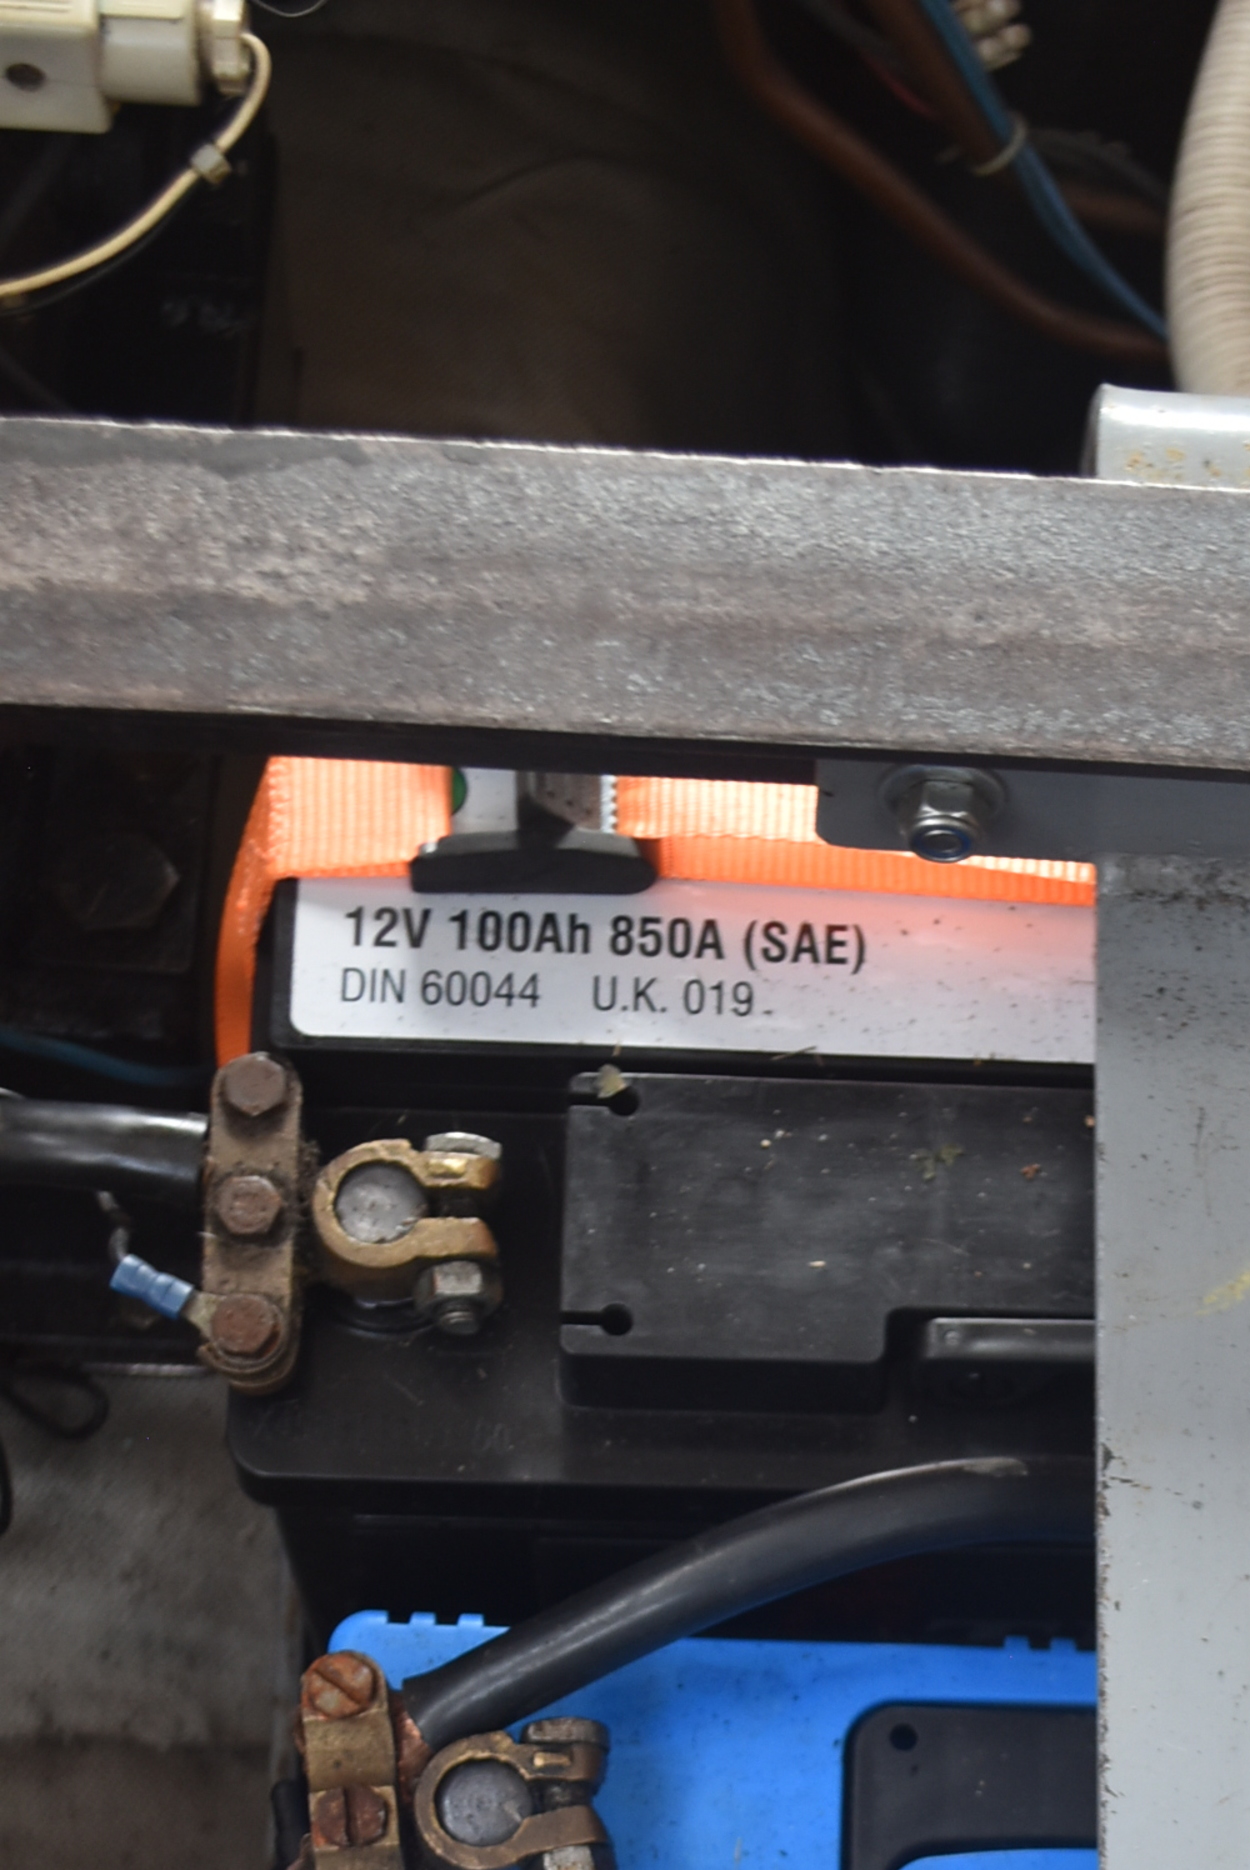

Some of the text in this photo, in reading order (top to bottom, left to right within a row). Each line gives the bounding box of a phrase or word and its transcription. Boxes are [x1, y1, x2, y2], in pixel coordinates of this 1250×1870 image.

[345, 906, 865, 975] 12V 100Ah 850A (SAE)
[340, 967, 405, 1004] DIN
[421, 968, 540, 1008] 60044
[592, 975, 667, 1014] U.K.
